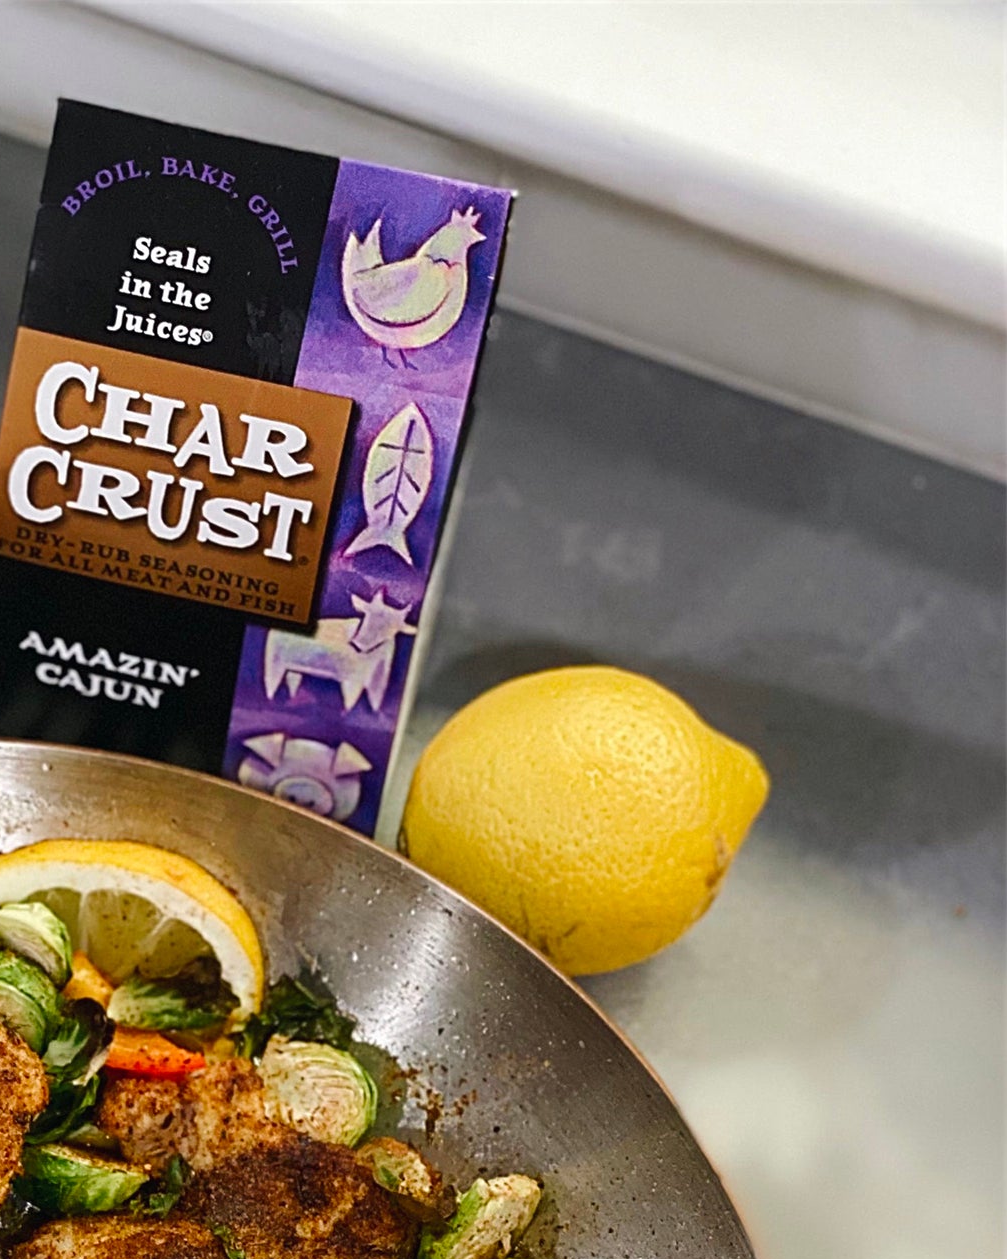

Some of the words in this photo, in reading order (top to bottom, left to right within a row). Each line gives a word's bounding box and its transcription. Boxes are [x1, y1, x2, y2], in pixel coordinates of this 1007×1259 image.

[61, 160, 150, 216] BROIL,
[161, 156, 239, 199] BAKE,
[247, 194, 298, 275] GRILL
[133, 236, 211, 274] Seals
[119, 270, 152, 299] in
[159, 281, 212, 311] the
[35, 361, 314, 478] CHAR
[16, 526, 130, 562] DRY-RUB
[139, 554, 279, 596] SEASONING
[45, 552, 93, 572] ALL
[101, 563, 173, 590] MEAT
[177, 580, 231, 602] AND
[239, 593, 296, 617] FISH
[35, 662, 164, 709] CAJUN
